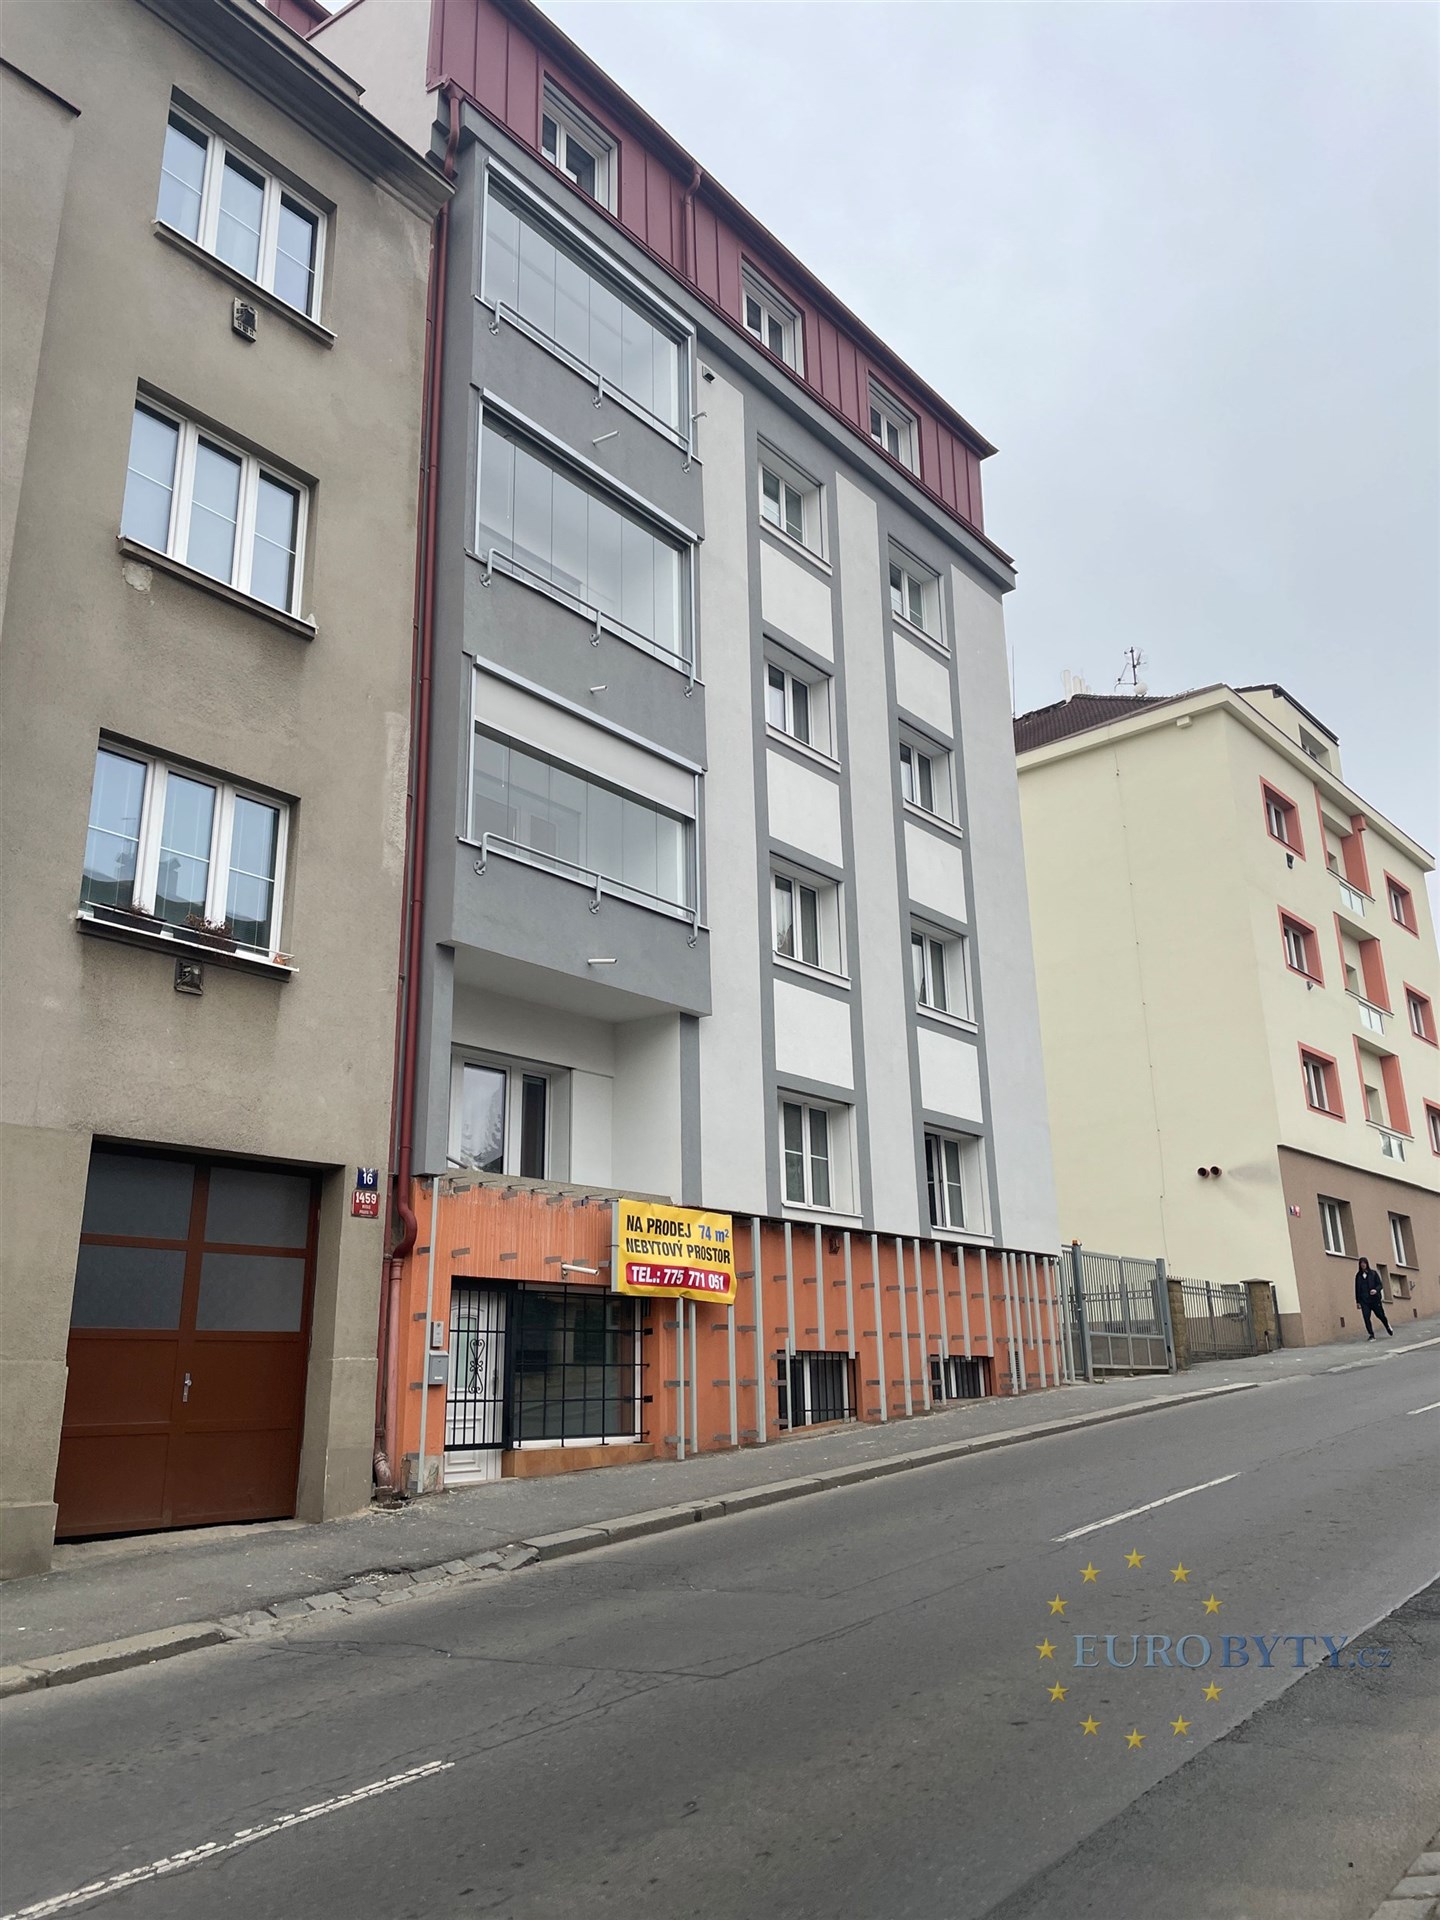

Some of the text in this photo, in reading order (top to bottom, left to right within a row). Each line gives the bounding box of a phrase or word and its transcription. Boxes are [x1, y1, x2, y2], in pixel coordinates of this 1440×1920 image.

[363, 1173, 373, 1184] 16
[356, 1192, 376, 1204] 1459
[627, 1215, 643, 1232] NA
[647, 1218, 691, 1238] PRODEJ
[698, 1225, 711, 1240] 74
[626, 1238, 730, 1264] NEBYTOVÝ PROSTOR
[632, 1266, 724, 1290] TEL.: 775 771 051
